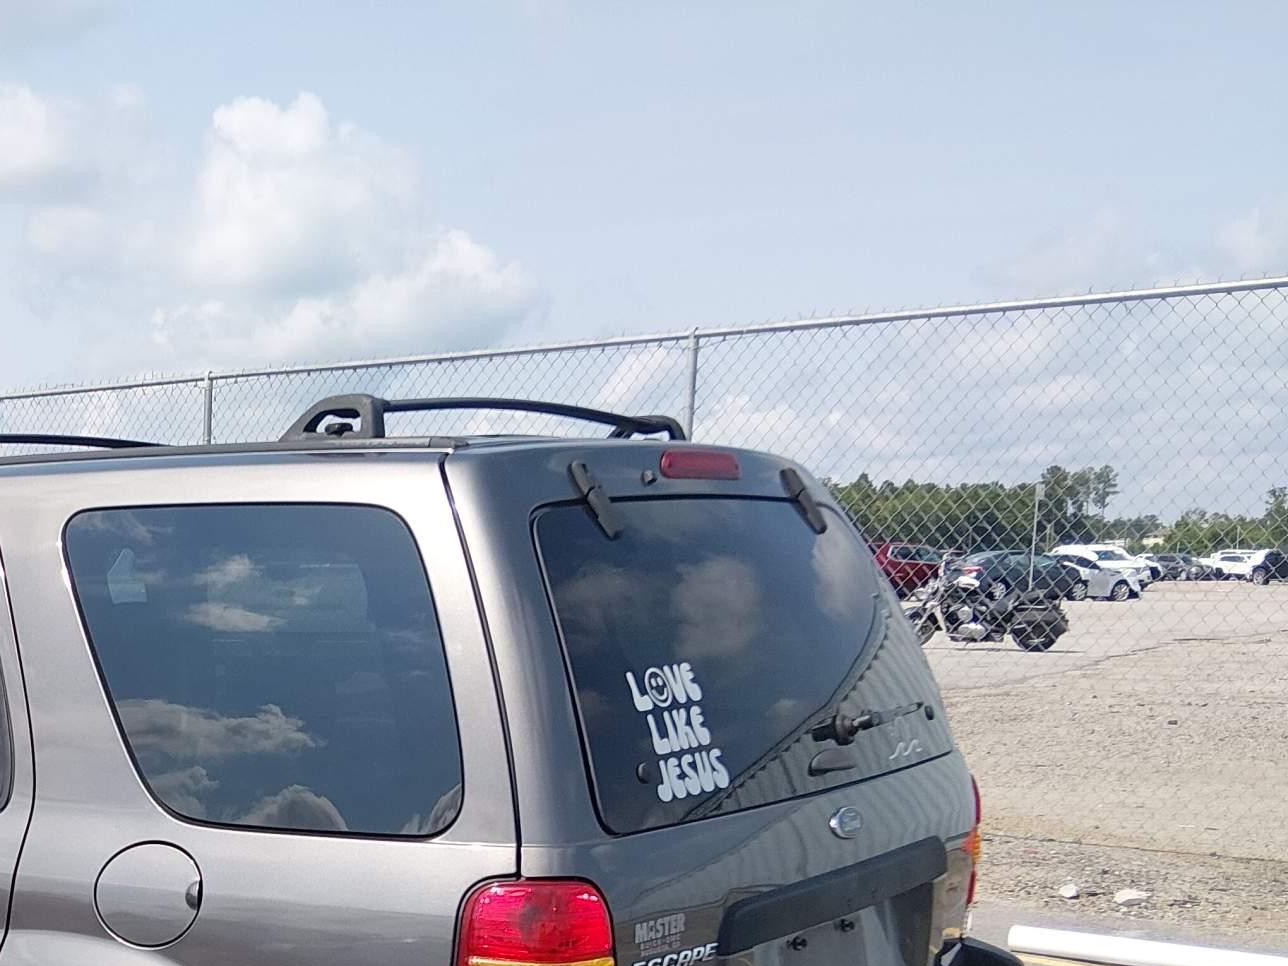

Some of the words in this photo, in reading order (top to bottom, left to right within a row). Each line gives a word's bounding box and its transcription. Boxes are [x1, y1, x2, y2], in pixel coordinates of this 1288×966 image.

[625, 661, 703, 712] LOVE
[646, 705, 711, 755] LIKE
[657, 748, 730, 802] JESUS
[634, 913, 686, 944] MASTER
